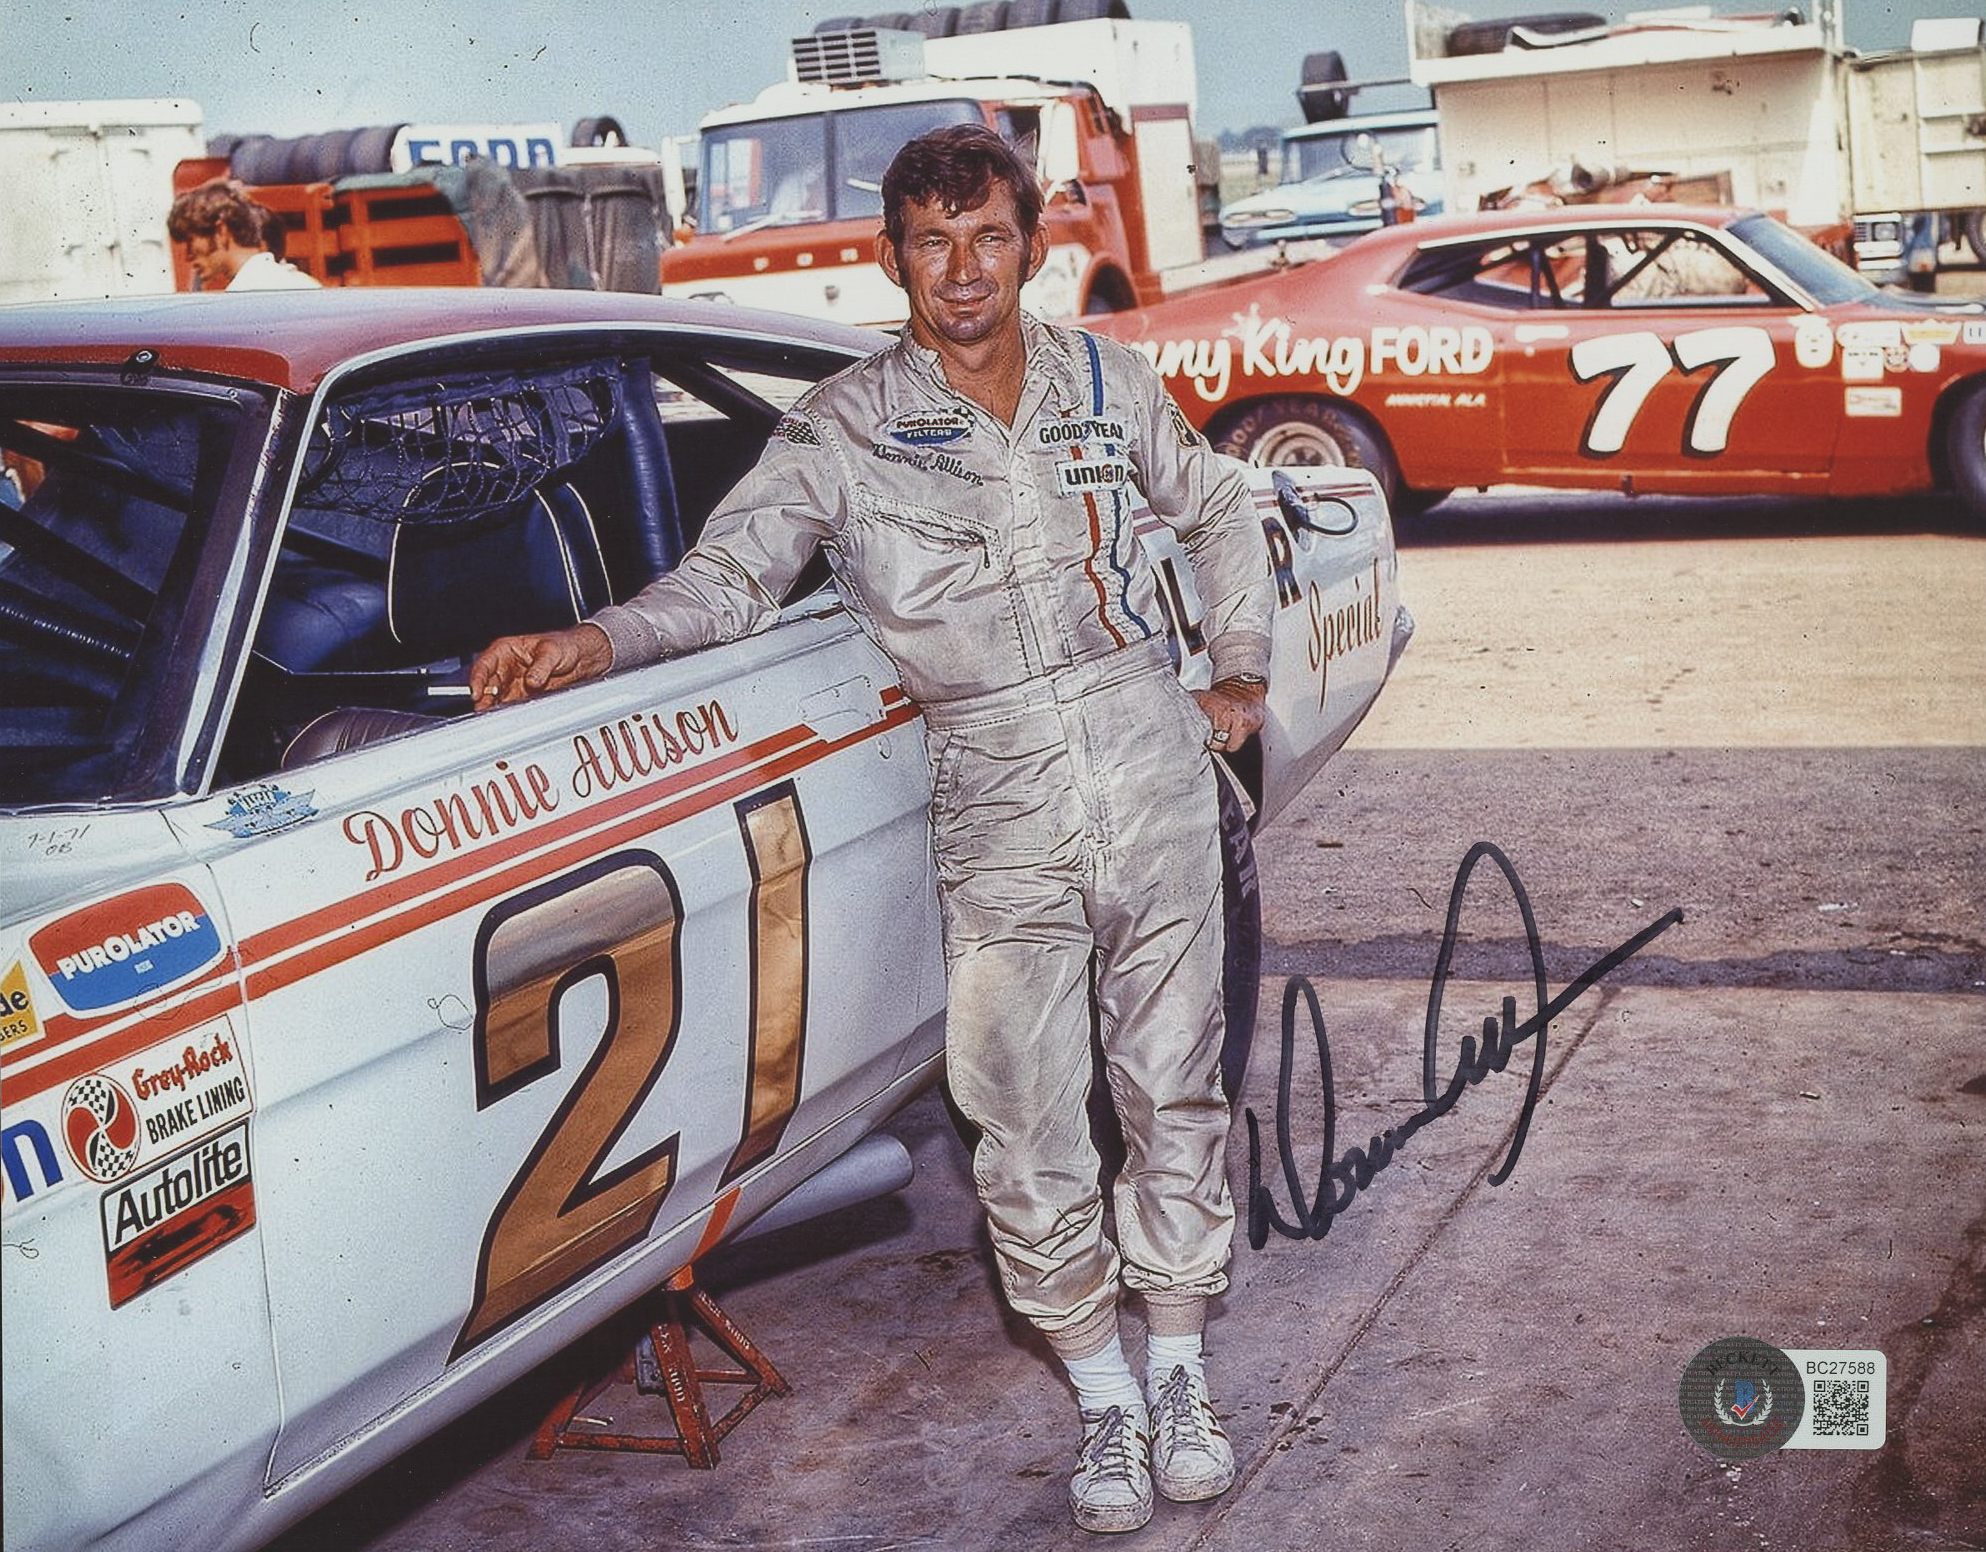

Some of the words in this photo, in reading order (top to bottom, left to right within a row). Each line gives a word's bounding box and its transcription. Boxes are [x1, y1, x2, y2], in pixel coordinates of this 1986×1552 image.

[1243, 317, 1364, 396] King
[1371, 326, 1494, 376] FORD
[1567, 326, 1777, 459] 77
[896, 417, 959, 429] PUROLATOR
[1308, 557, 1383, 713] Special
[342, 760, 560, 882] Donnie
[571, 698, 739, 798] Allison
[56, 910, 200, 981] PUROLATOR
[132, 1033, 233, 1101] Grey-Rock
[146, 1098, 198, 1145] BRAKE
[196, 1076, 246, 1121] LINING
[445, 778, 812, 1366] 21
[114, 1141, 244, 1245] Autolite
